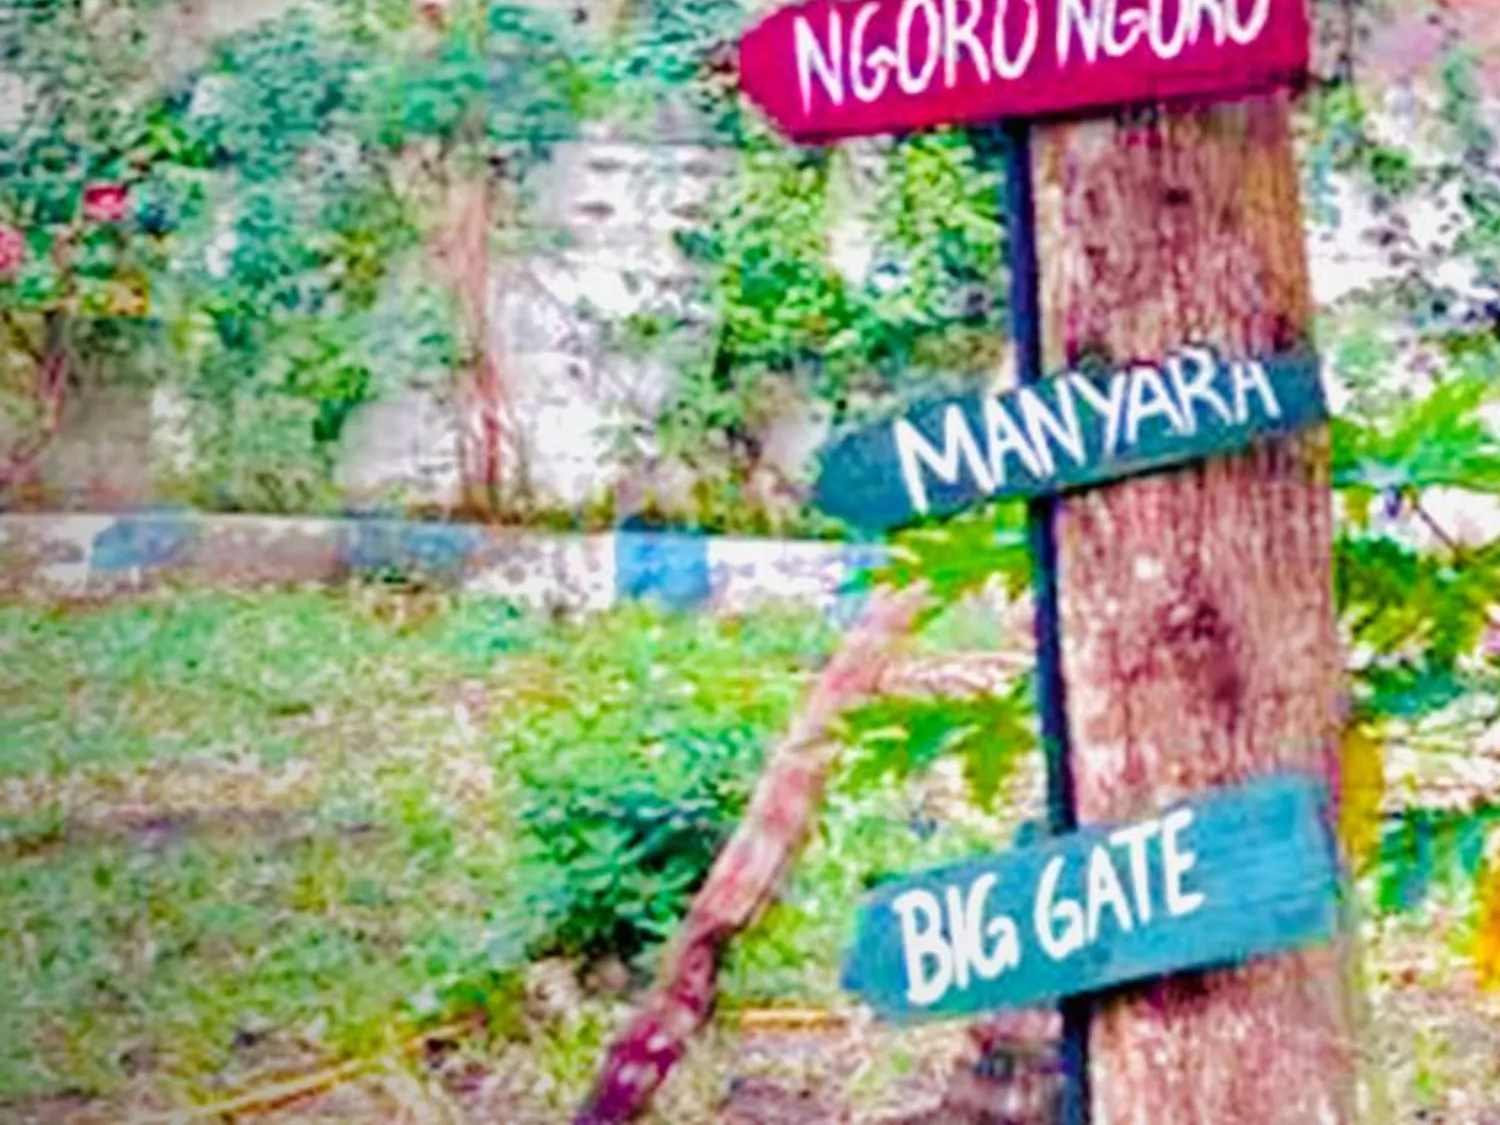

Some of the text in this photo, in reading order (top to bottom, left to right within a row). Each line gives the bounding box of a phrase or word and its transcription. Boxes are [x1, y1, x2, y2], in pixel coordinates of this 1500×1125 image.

[894, 349, 1281, 515] MANYARA
[892, 808, 1206, 1007] BIG GATE
